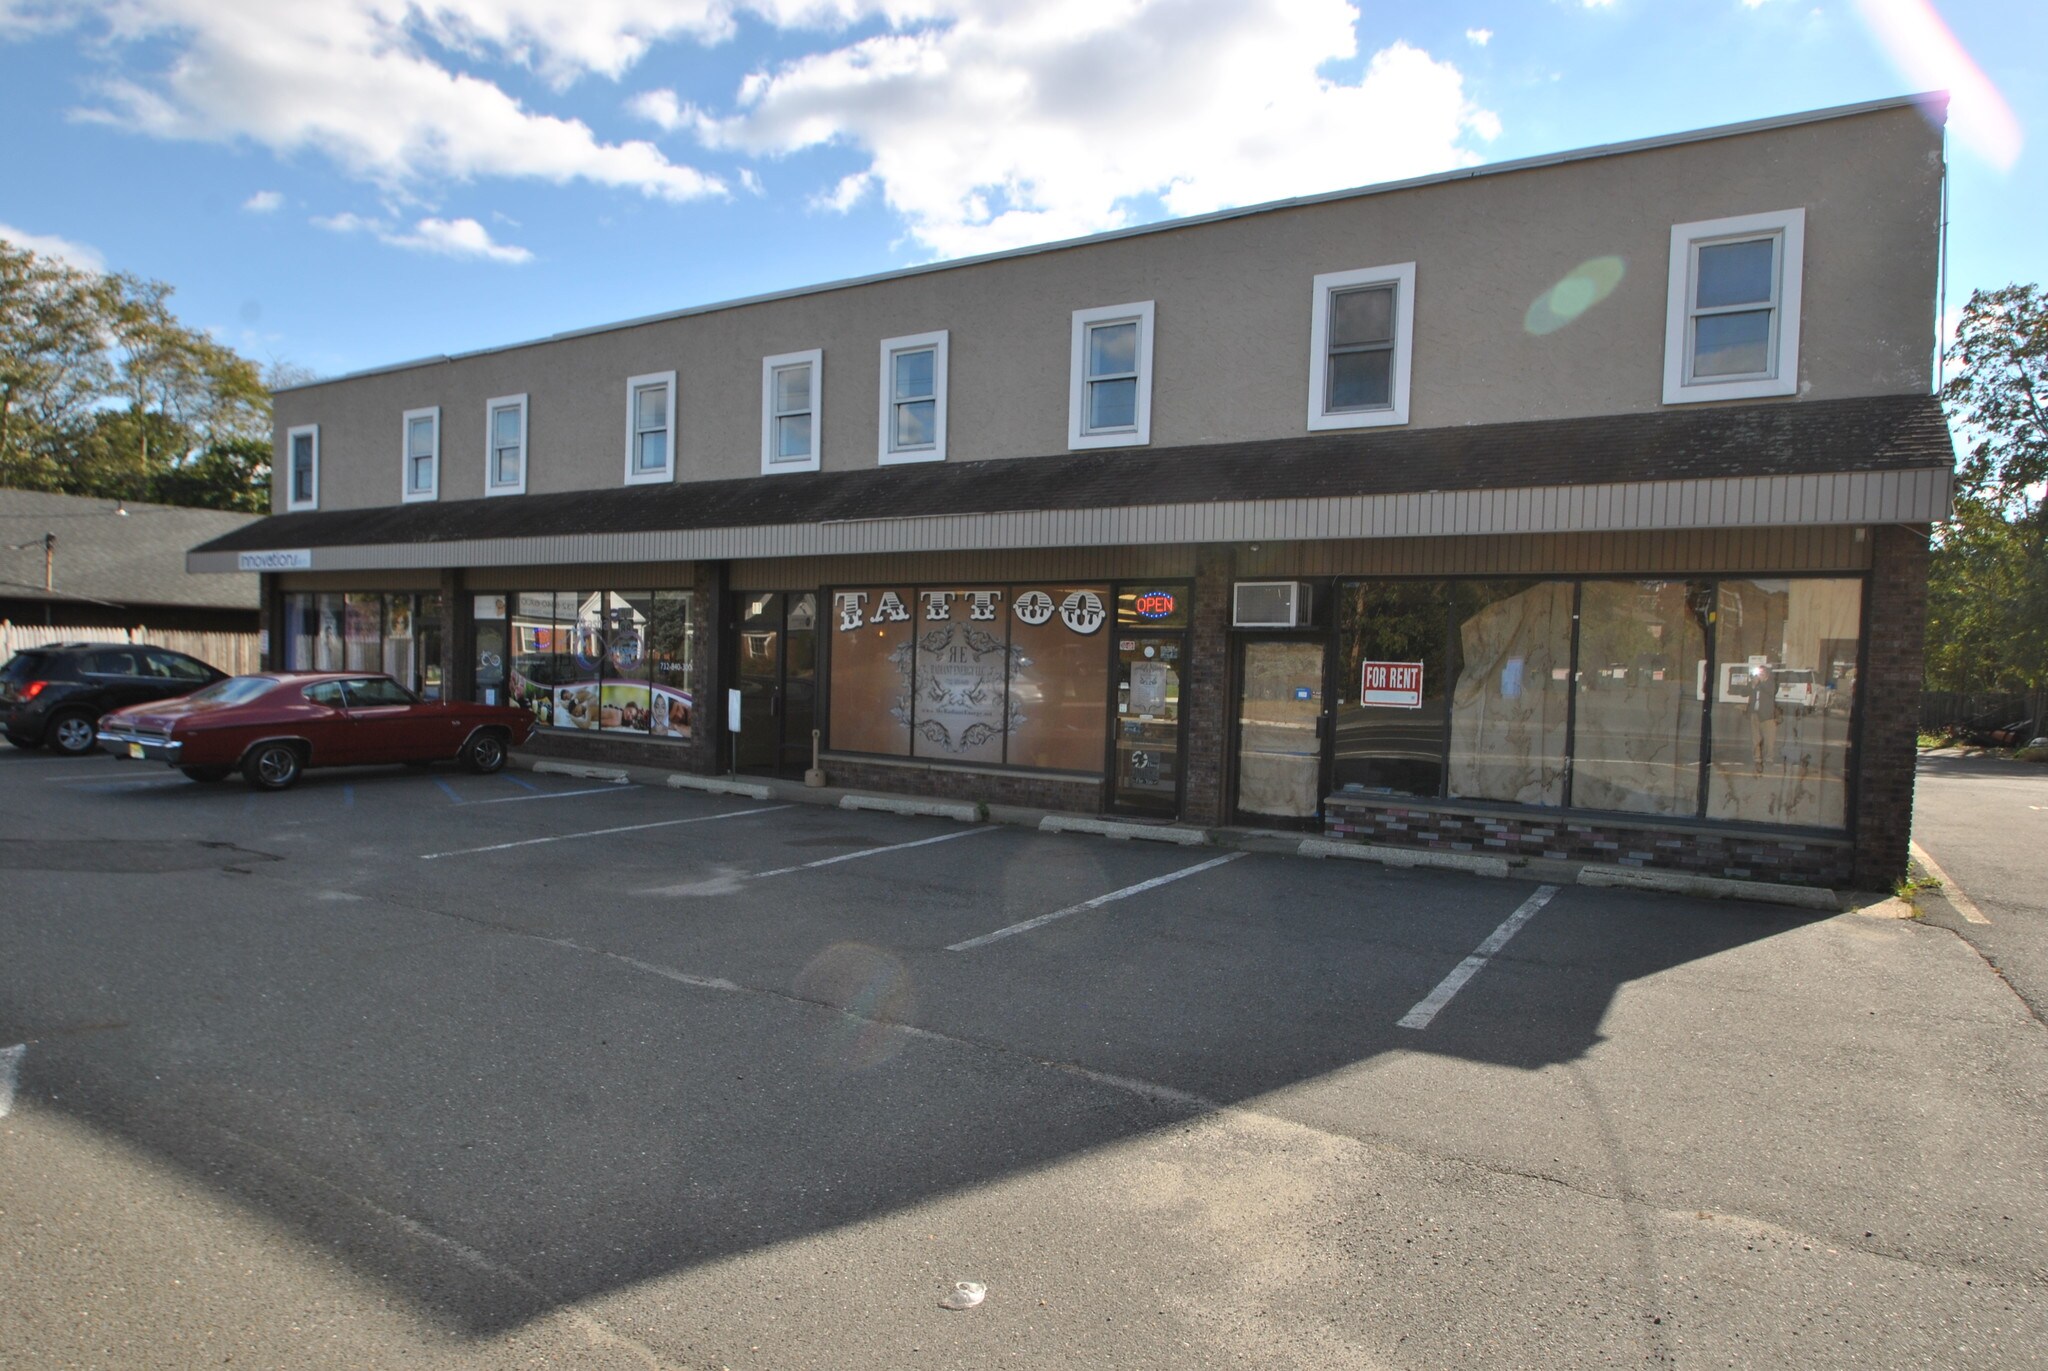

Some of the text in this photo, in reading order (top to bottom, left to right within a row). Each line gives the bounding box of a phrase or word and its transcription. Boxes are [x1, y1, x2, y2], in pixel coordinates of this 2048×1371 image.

[835, 591, 1106, 634] TATTOO
[1137, 597, 1173, 612] OPEN
[1366, 666, 1418, 689] FOR RENT
